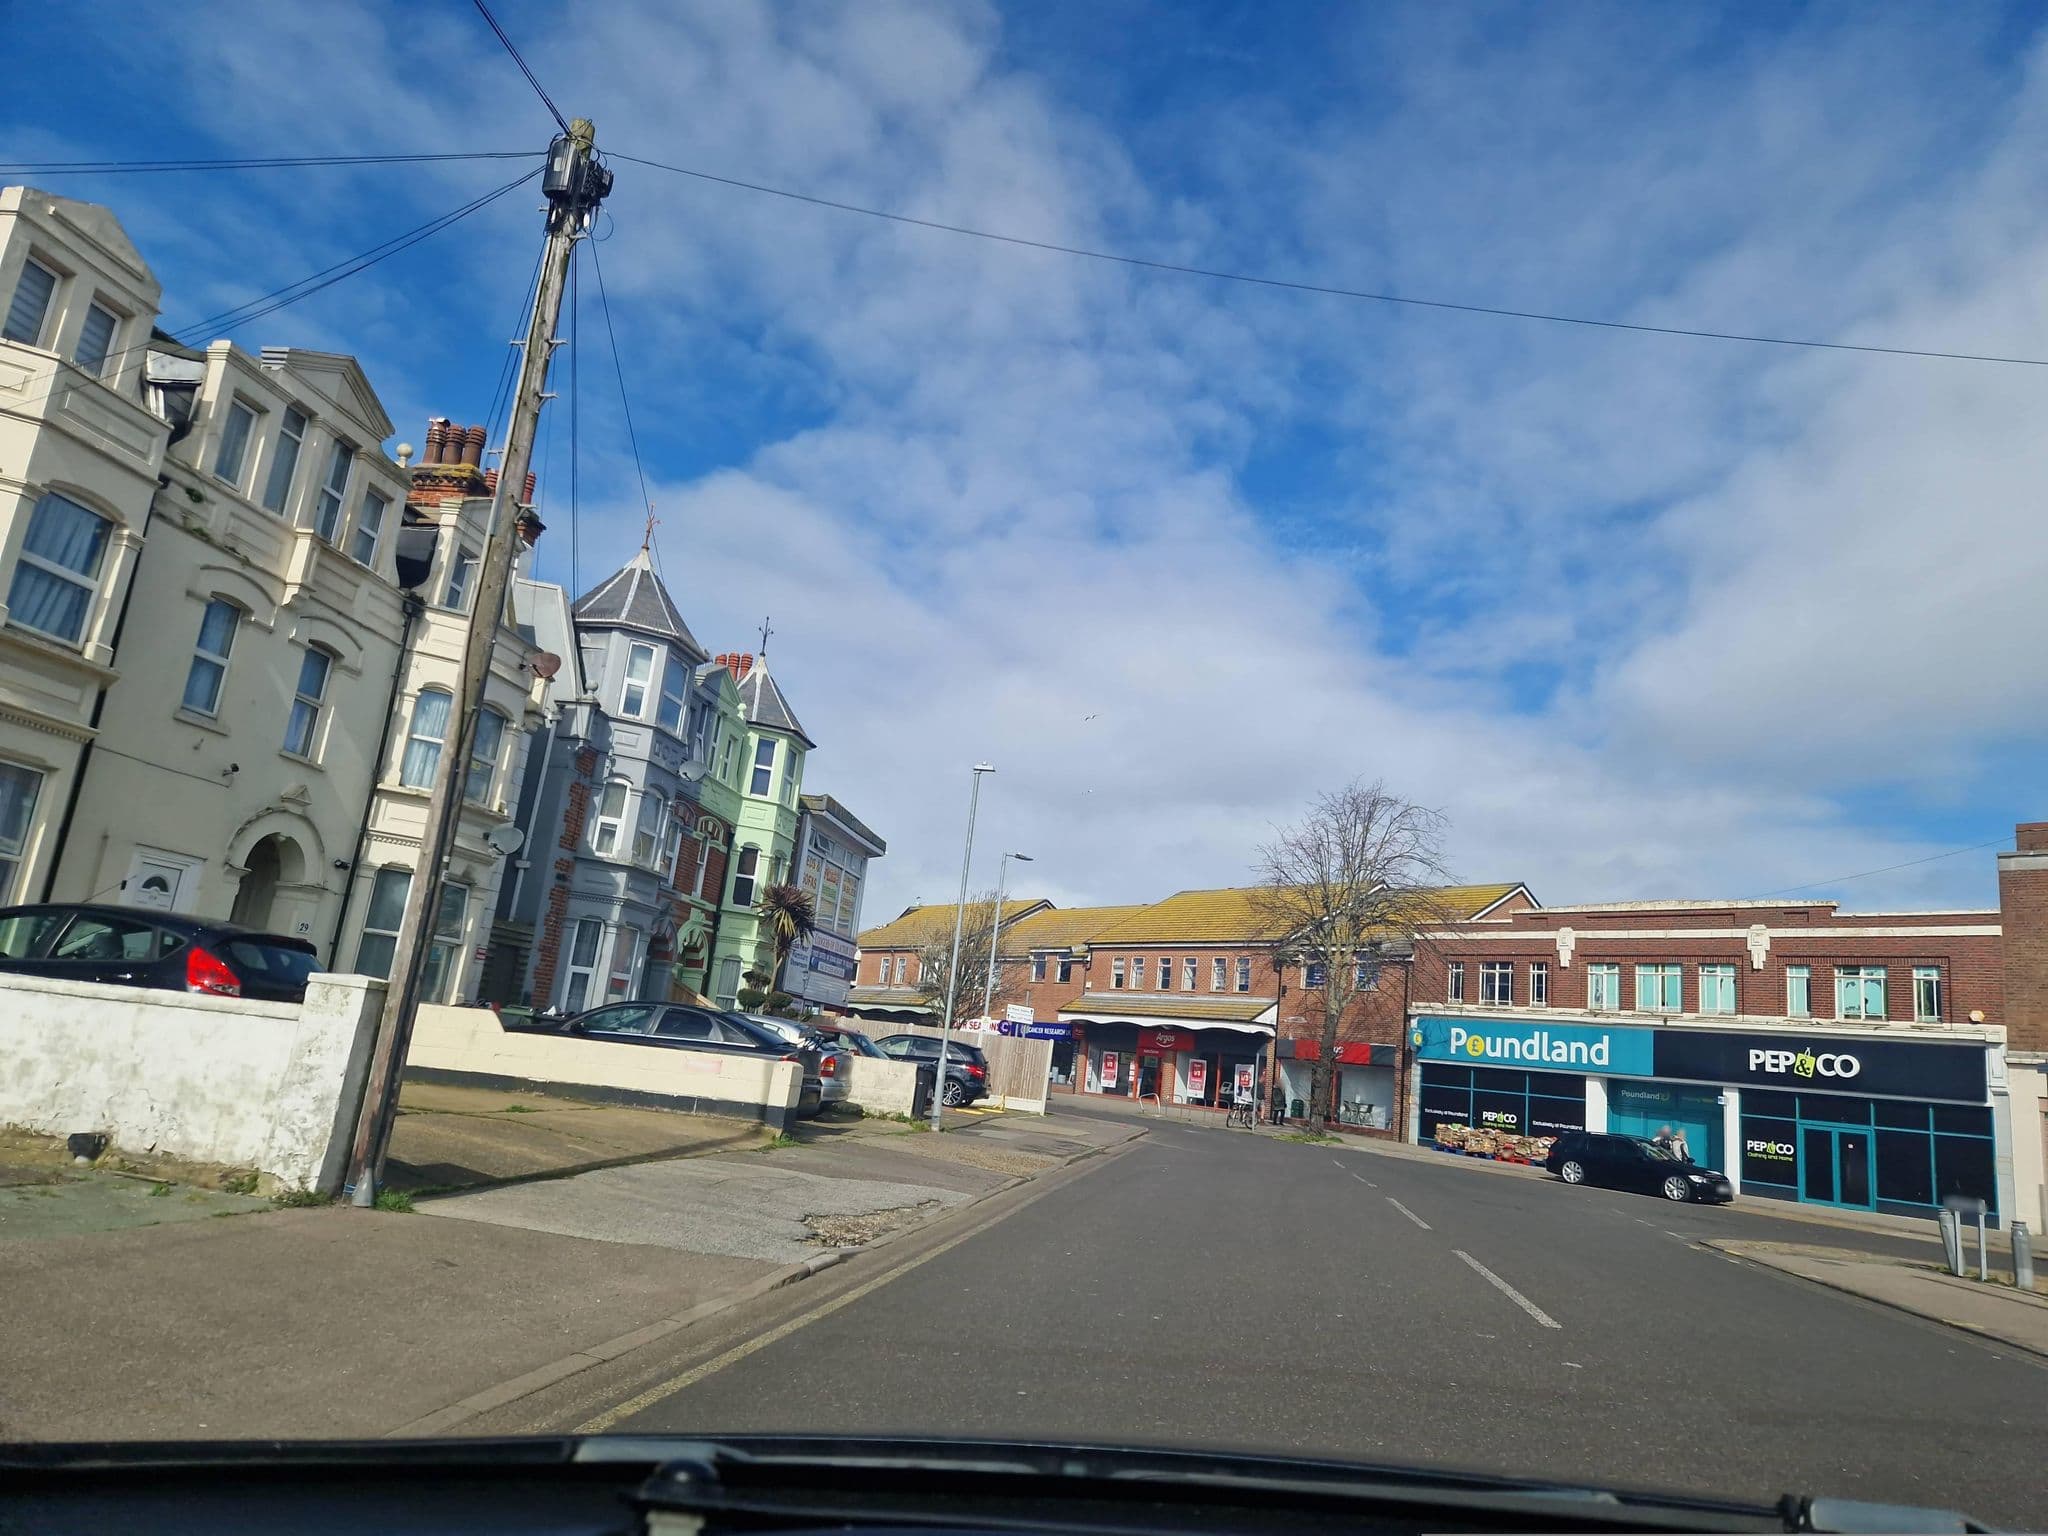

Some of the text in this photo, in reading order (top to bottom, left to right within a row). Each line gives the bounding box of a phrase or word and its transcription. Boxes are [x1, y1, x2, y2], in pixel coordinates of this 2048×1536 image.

[299, 922, 309, 932] 29
[1044, 1028, 1066, 1036] RESEARCH
[1156, 1033, 1175, 1044] Argos
[1621, 1089, 1660, 1100] Poundland
[1447, 1110, 1469, 1118] Poundland
[1532, 1120, 1554, 1129] Exclusively
[1560, 1123, 1583, 1131] Poundland
[1747, 1152, 1767, 1160] Clothing
